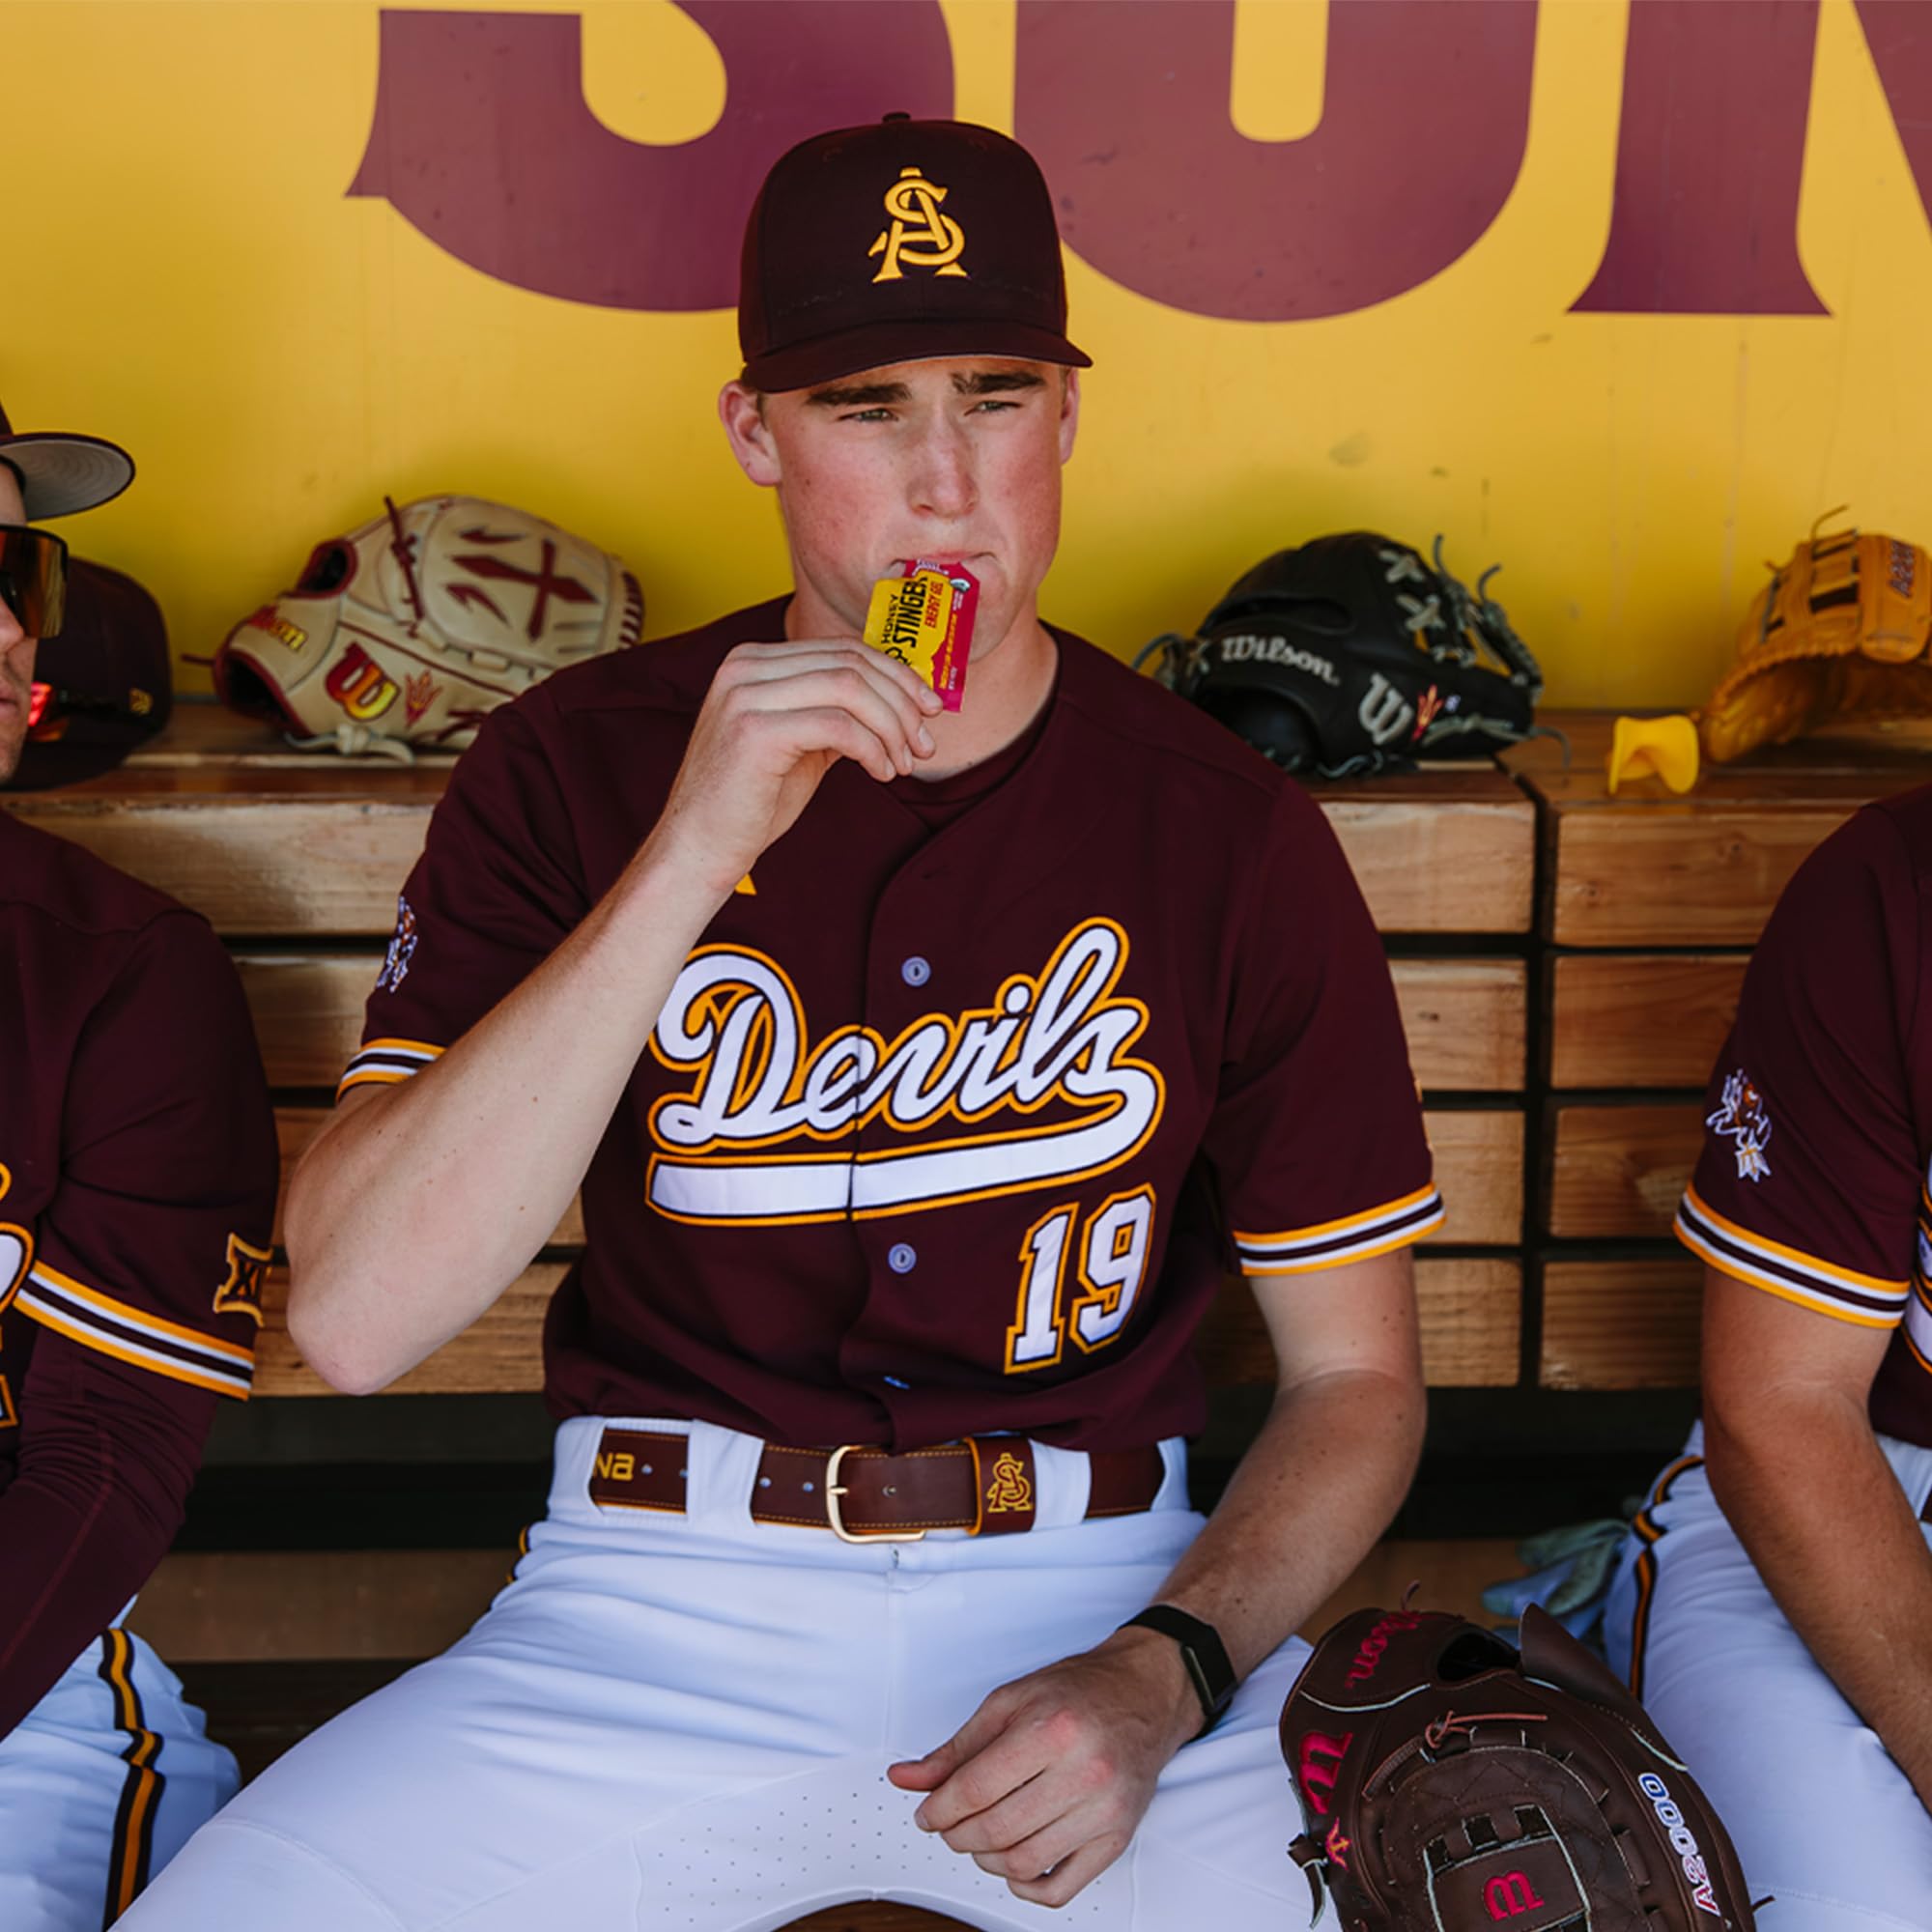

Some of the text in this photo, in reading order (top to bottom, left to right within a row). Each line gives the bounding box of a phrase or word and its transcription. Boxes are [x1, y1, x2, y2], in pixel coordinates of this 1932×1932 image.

[881, 594, 899, 644] HONEY
[892, 577, 928, 648] STINGER
[924, 595, 941, 629] ENERGY
[929, 581, 944, 595] GEL
[647, 916, 1166, 1226] Devils
[1004, 1182, 1156, 1374] 19
[1638, 1773, 1720, 1918] A2000
